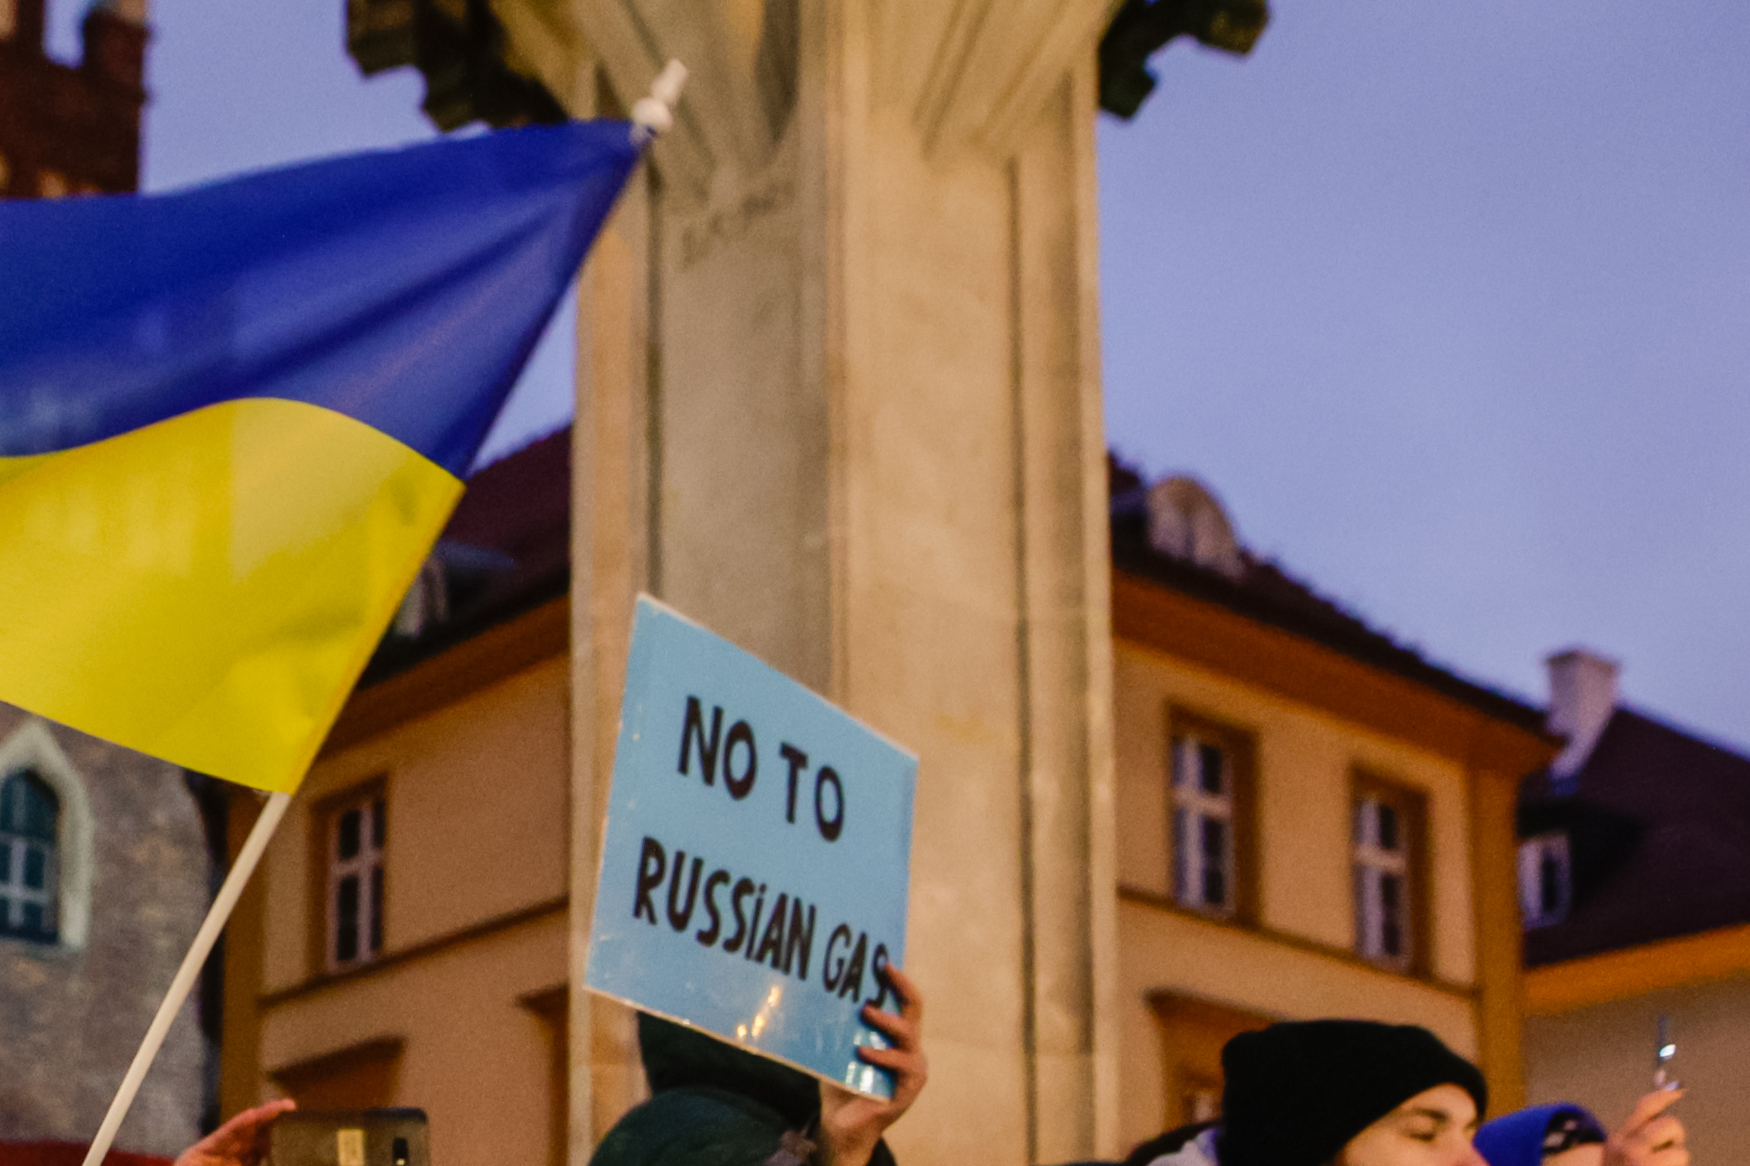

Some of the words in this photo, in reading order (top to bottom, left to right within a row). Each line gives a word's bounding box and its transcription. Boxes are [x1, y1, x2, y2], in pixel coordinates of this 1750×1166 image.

[678, 695, 757, 800] NO
[779, 741, 845, 842] TO
[823, 924, 892, 1009] GAS
